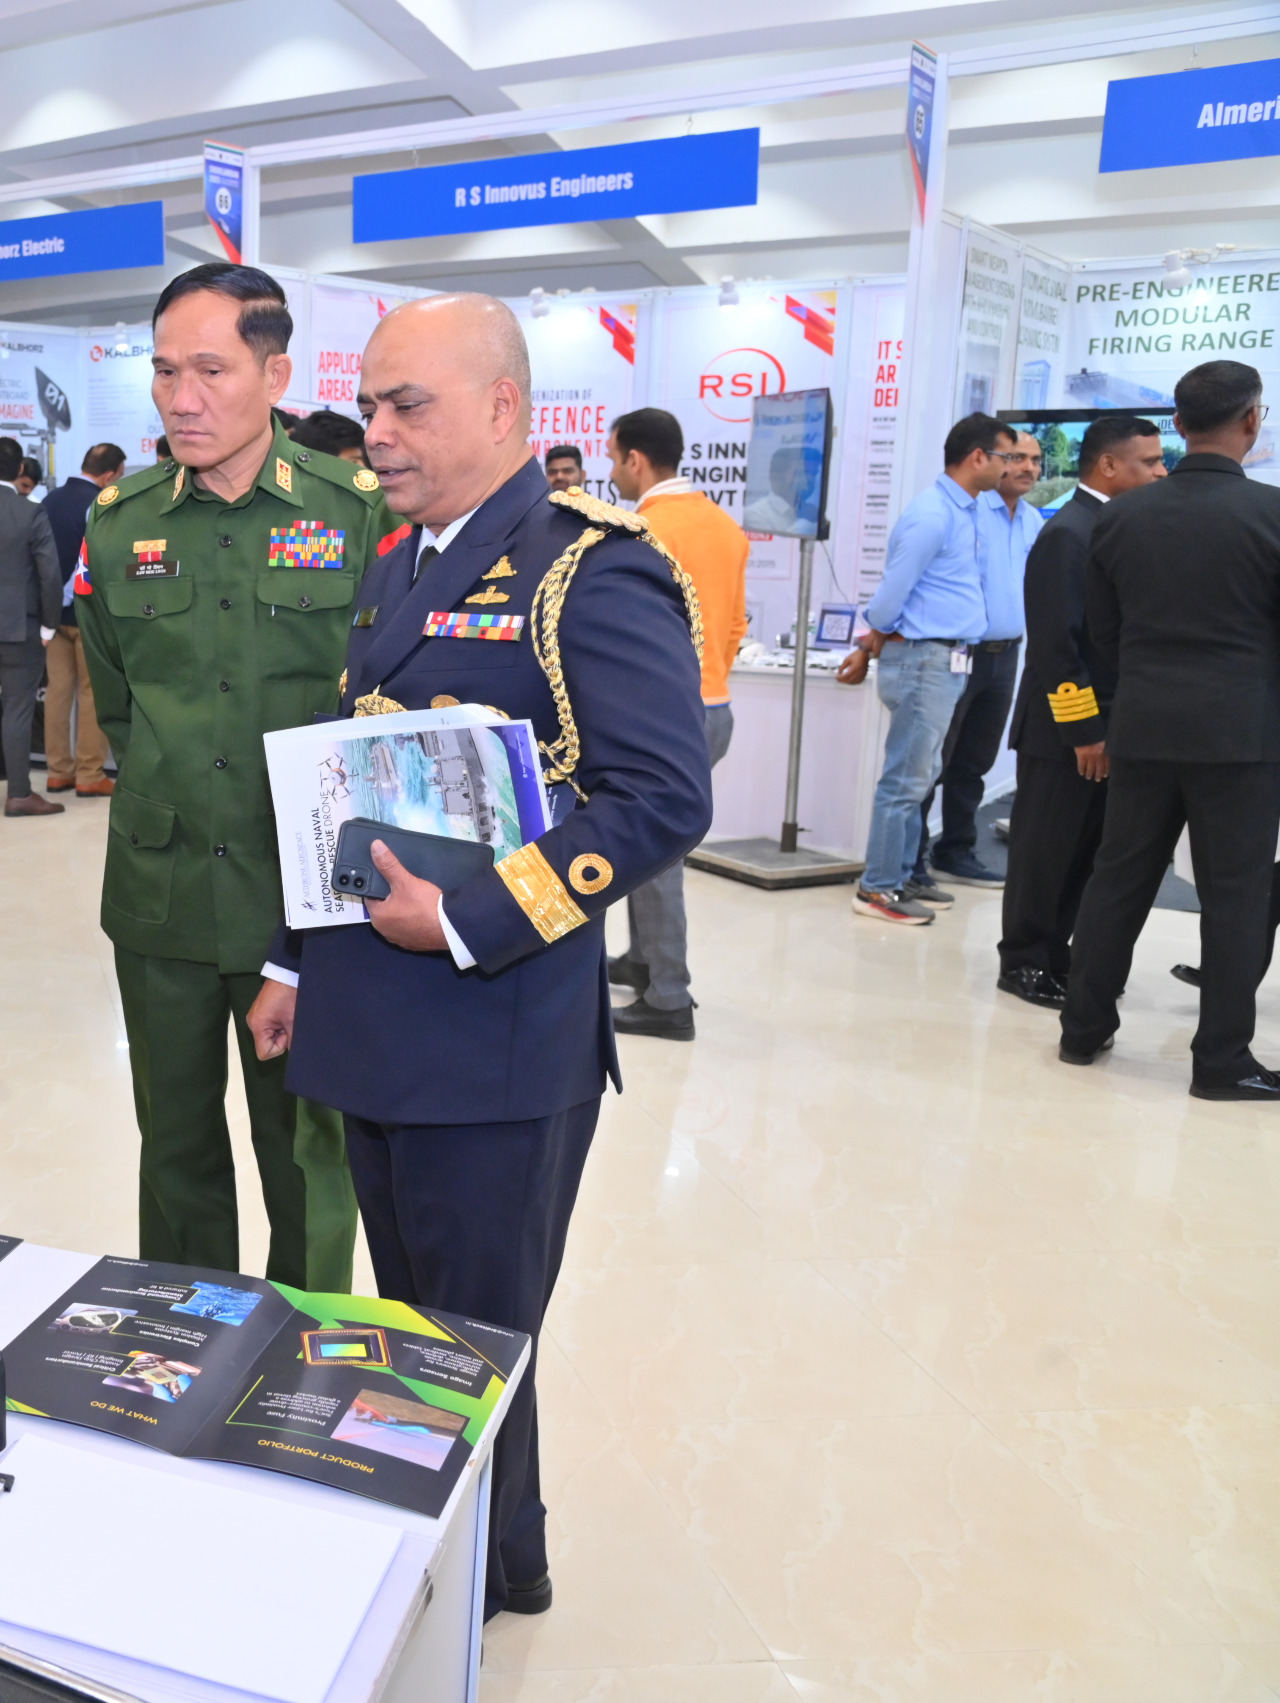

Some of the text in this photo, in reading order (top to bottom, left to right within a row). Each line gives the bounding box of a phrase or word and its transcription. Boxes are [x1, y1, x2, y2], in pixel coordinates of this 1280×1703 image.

[1196, 94, 1280, 129] Almeri
[455, 171, 634, 208] R S Innovus Engineers
[21, 236, 65, 257] Electric
[1114, 302, 1252, 328] MODULAR
[1, 342, 44, 354] KALBHORZ
[878, 340, 892, 360] IT
[1088, 328, 1275, 356] FIRING RANGE
[318, 378, 354, 402] AREAS
[699, 372, 768, 399] RSI
[690, 442, 747, 460] S INN
[320, 790, 333, 827] DRONE
[311, 807, 333, 914] AUTONOMOUS NAVAL
[139, 1329, 200, 1347] Complex Electronics
[92, 1363, 116, 1372] Critical
[419, 1367, 473, 1387] Image Sensors
[90, 1401, 158, 1425] WHAT WE DO
[266, 1411, 326, 1426] Proximity Fuze
[257, 1439, 375, 1474] PRODUCT PORTFOLIO
